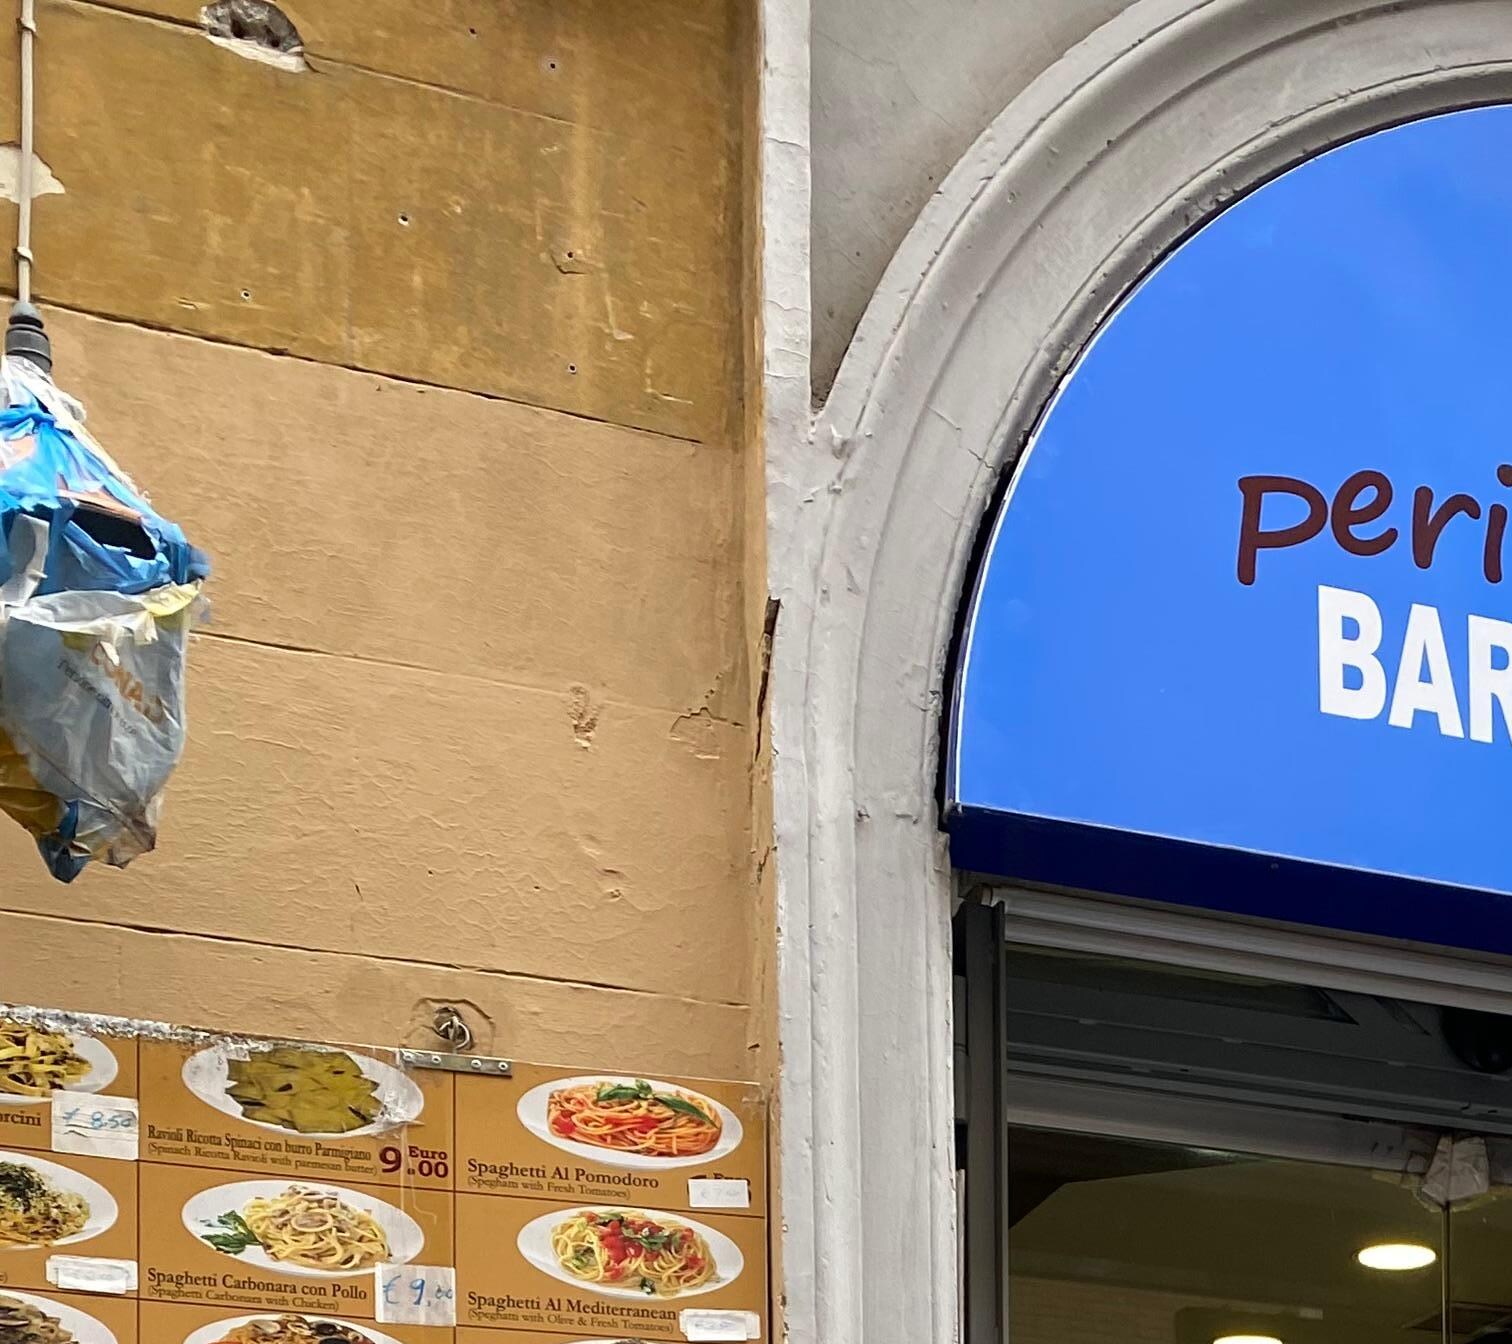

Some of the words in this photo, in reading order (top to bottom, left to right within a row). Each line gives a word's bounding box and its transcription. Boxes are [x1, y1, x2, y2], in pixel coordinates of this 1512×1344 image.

[148, 1125, 185, 1142] Ravioli
[187, 1129, 222, 1147] Ricotta
[225, 1135, 262, 1154] Spinaci
[264, 1140, 282, 1152] con
[285, 1139, 312, 1155] burro
[315, 1144, 371, 1163] Parmigiano
[409, 1146, 447, 1160] Euro
[468, 1160, 546, 1180] Spaghetti
[552, 1166, 569, 1181] Al
[576, 1168, 658, 1188] Pomodoro
[148, 1268, 217, 1289] Spaghetti
[222, 1275, 297, 1296] Carbonara
[301, 1283, 330, 1298] con
[333, 1284, 366, 1300] Pollo
[468, 1292, 541, 1312] Spaghetti
[546, 1298, 562, 1312] Al
[566, 1299, 676, 1320] Mediterranean
